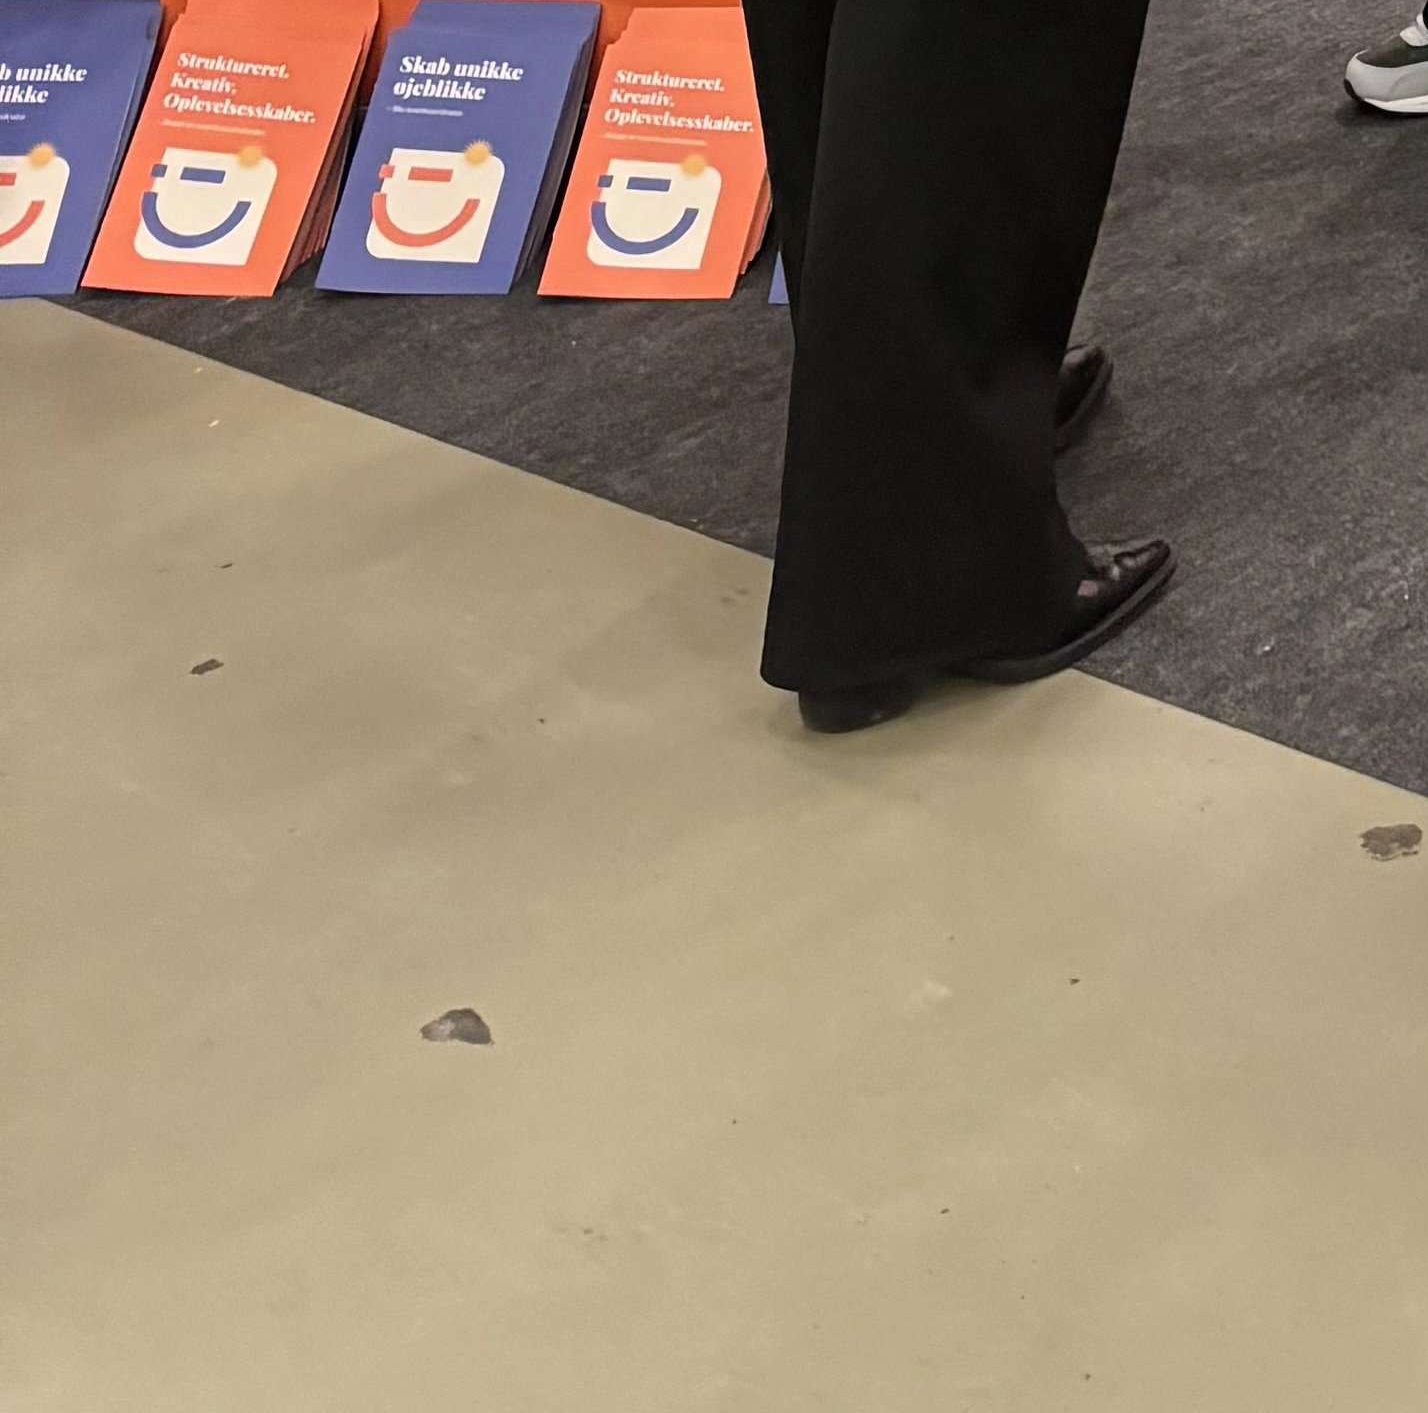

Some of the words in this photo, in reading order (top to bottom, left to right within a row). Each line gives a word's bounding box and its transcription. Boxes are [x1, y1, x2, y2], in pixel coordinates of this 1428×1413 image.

[15, 63, 87, 82] unikke
[178, 53, 289, 79] Struktureret.
[400, 56, 450, 76] Skab
[454, 60, 523, 81] unikke
[170, 72, 237, 94] Kreativ.
[393, 78, 486, 101] øjeblikke
[615, 69, 725, 92] Struktureret.
[163, 93, 316, 123] Oplevelsesskaber.
[609, 89, 675, 108] Kreativ.
[604, 108, 754, 134] Oplevelsesskaber.
